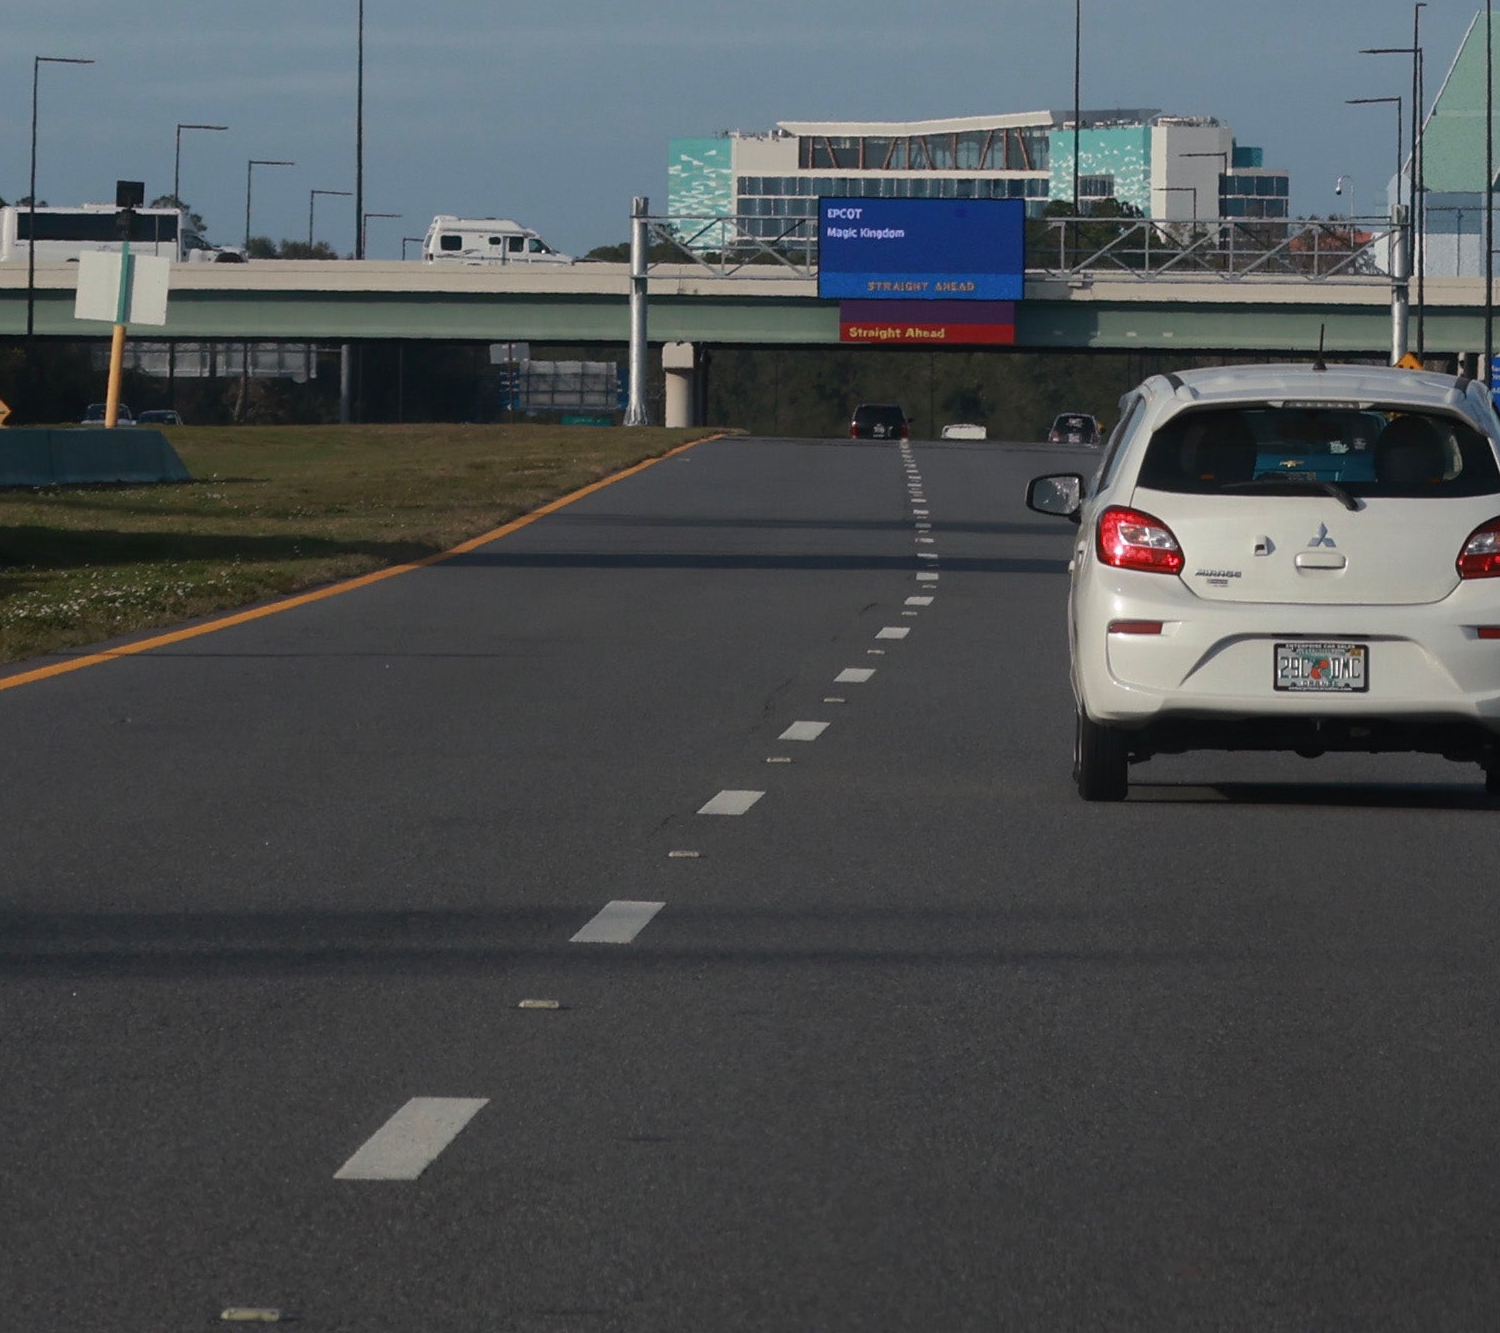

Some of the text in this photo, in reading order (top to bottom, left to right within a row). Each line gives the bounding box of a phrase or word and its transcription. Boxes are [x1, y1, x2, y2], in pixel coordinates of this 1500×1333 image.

[827, 208, 862, 219] EPCOT
[827, 227, 905, 239] Magic Kingdom
[867, 282, 975, 292] STRAIGHT AHEAD
[849, 327, 944, 340] Straight Ahead
